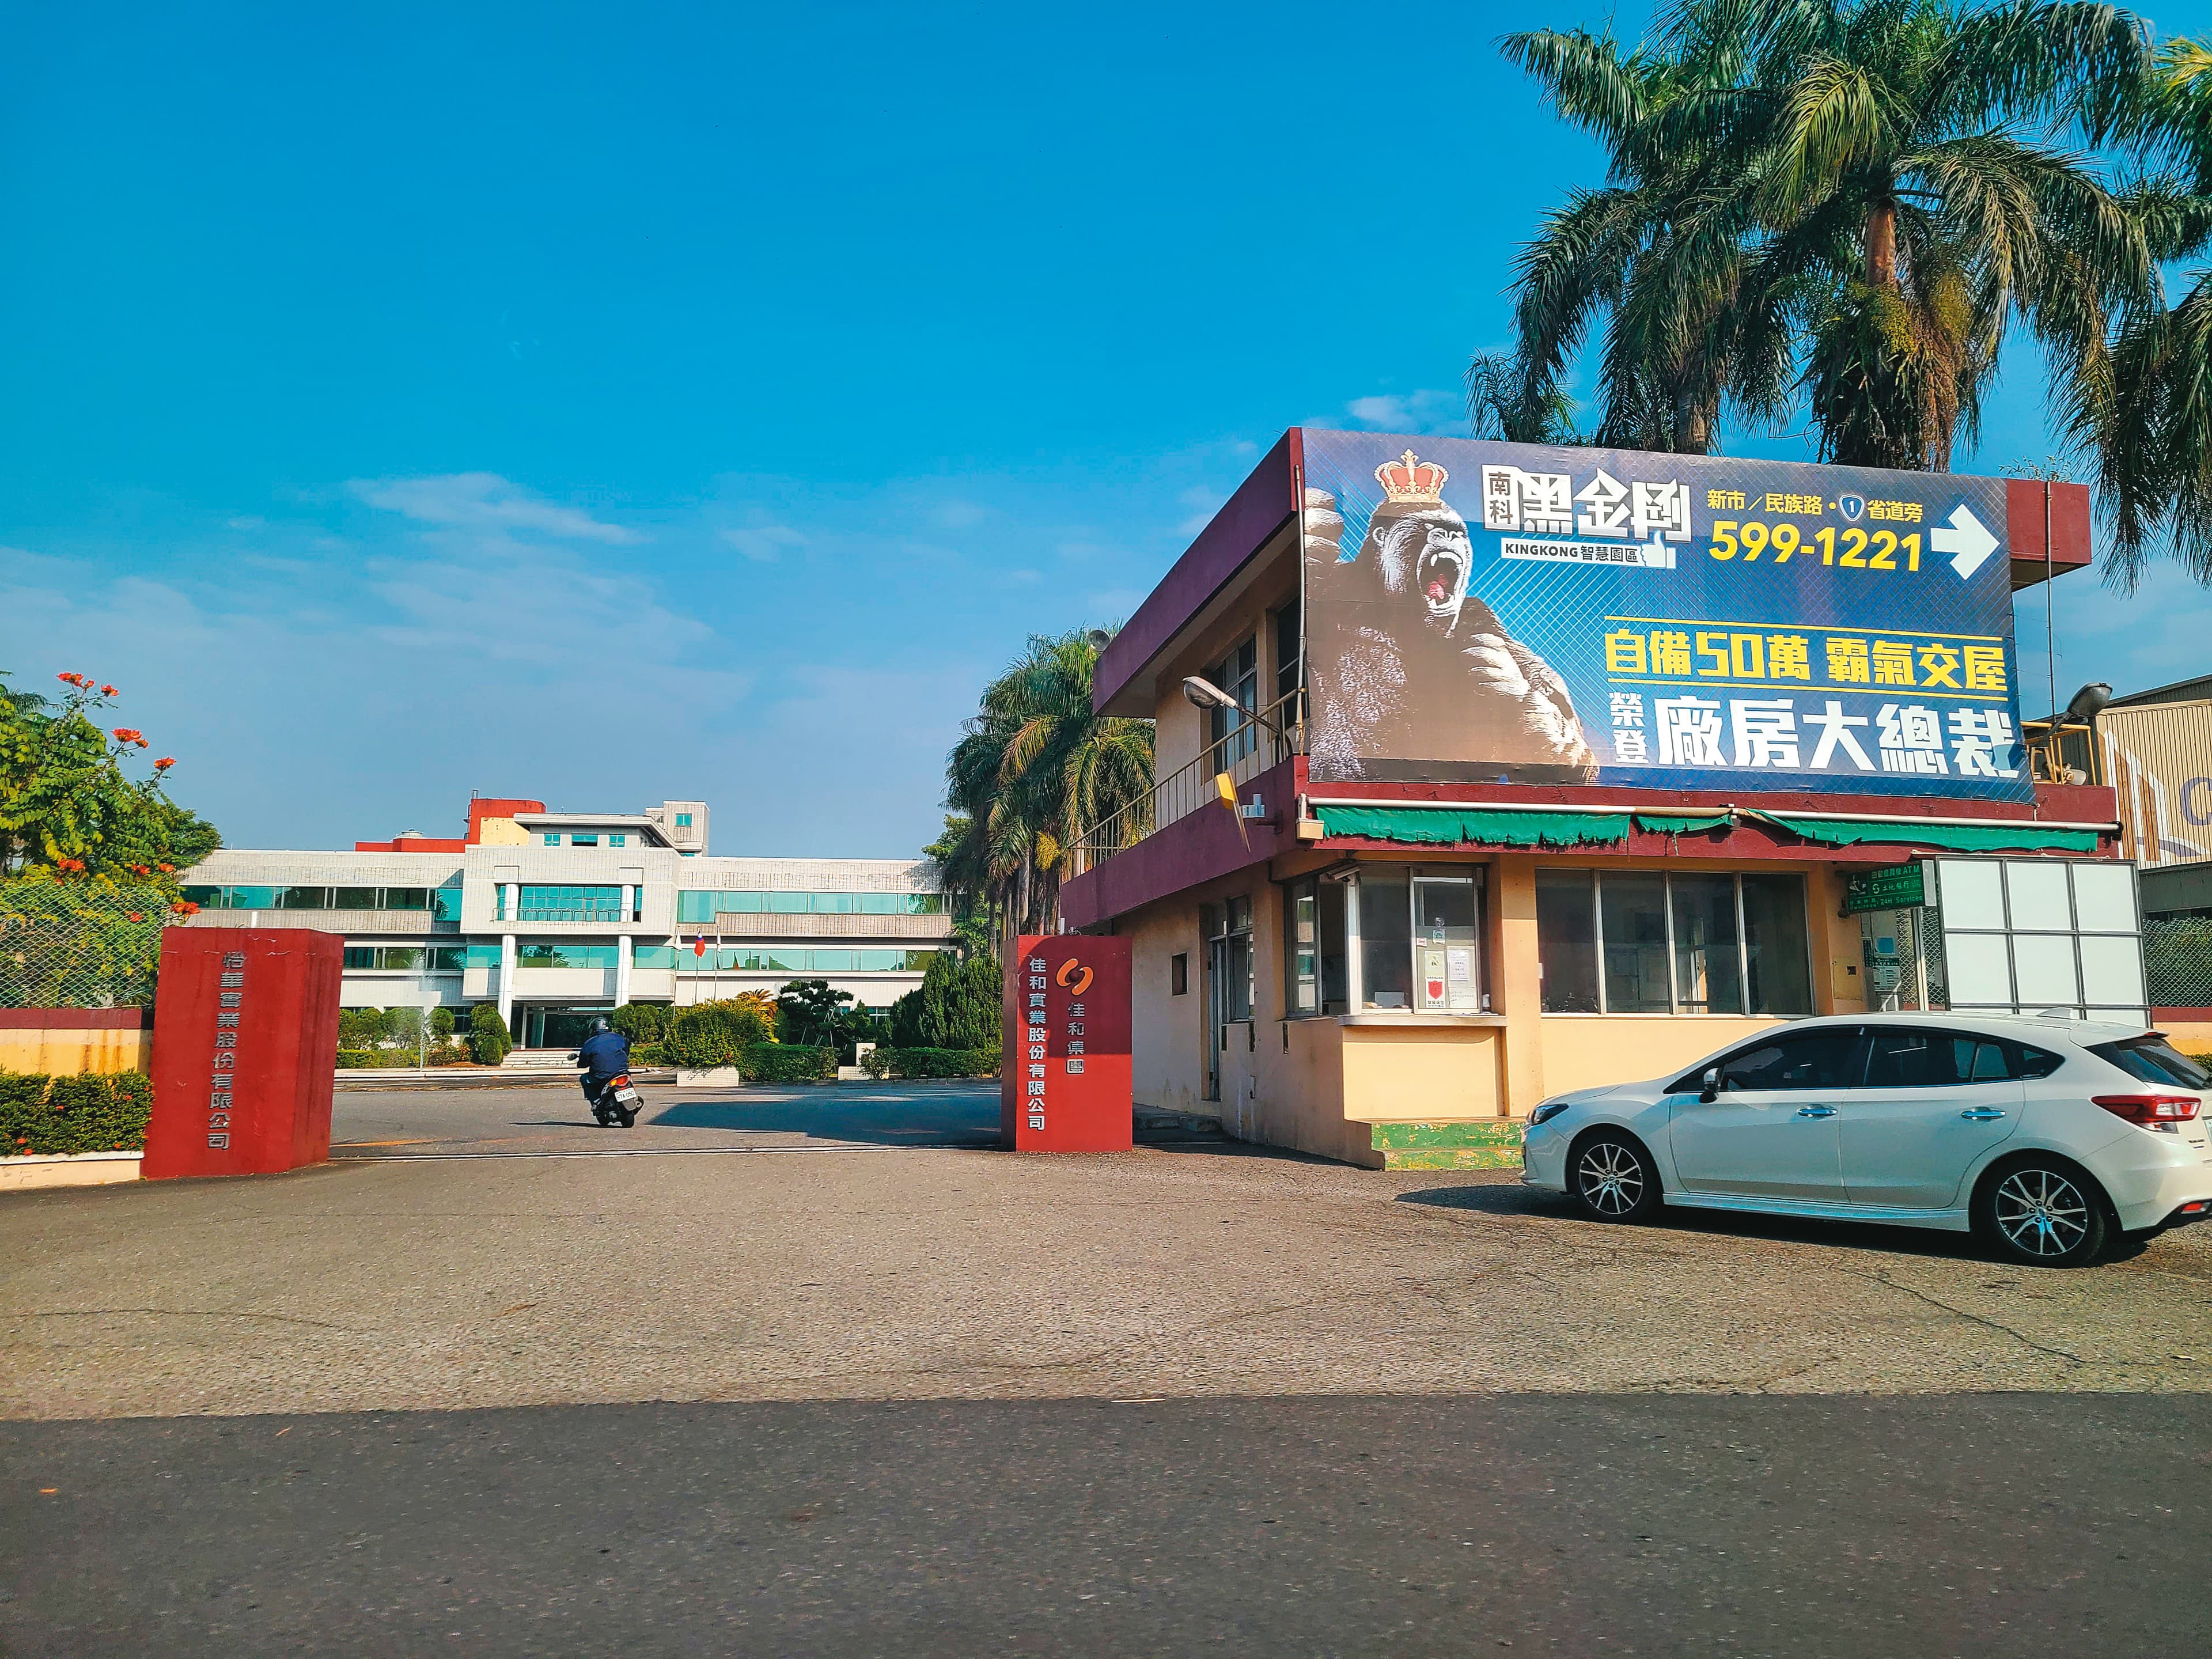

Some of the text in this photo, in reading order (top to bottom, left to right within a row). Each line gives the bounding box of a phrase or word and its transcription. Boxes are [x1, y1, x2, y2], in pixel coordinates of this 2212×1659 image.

[1488, 471, 1513, 524] 南科
[1517, 467, 1692, 542] 黑金剛
[1867, 499, 1923, 522] 省道旁
[1505, 543, 1638, 563] KINGKONG 智慧園區
[1709, 520, 1921, 572] 599-1221
[1605, 629, 2008, 691] 自備50萬 霸氣交屋
[1609, 692, 1649, 764] 榮登
[1654, 695, 2021, 779] 廠房大總裁
[1903, 865, 1920, 874] ATM
[1028, 958, 1047, 1131] 佳和實業股份有限公司
[1066, 1002, 1085, 1075] 佳和集團
